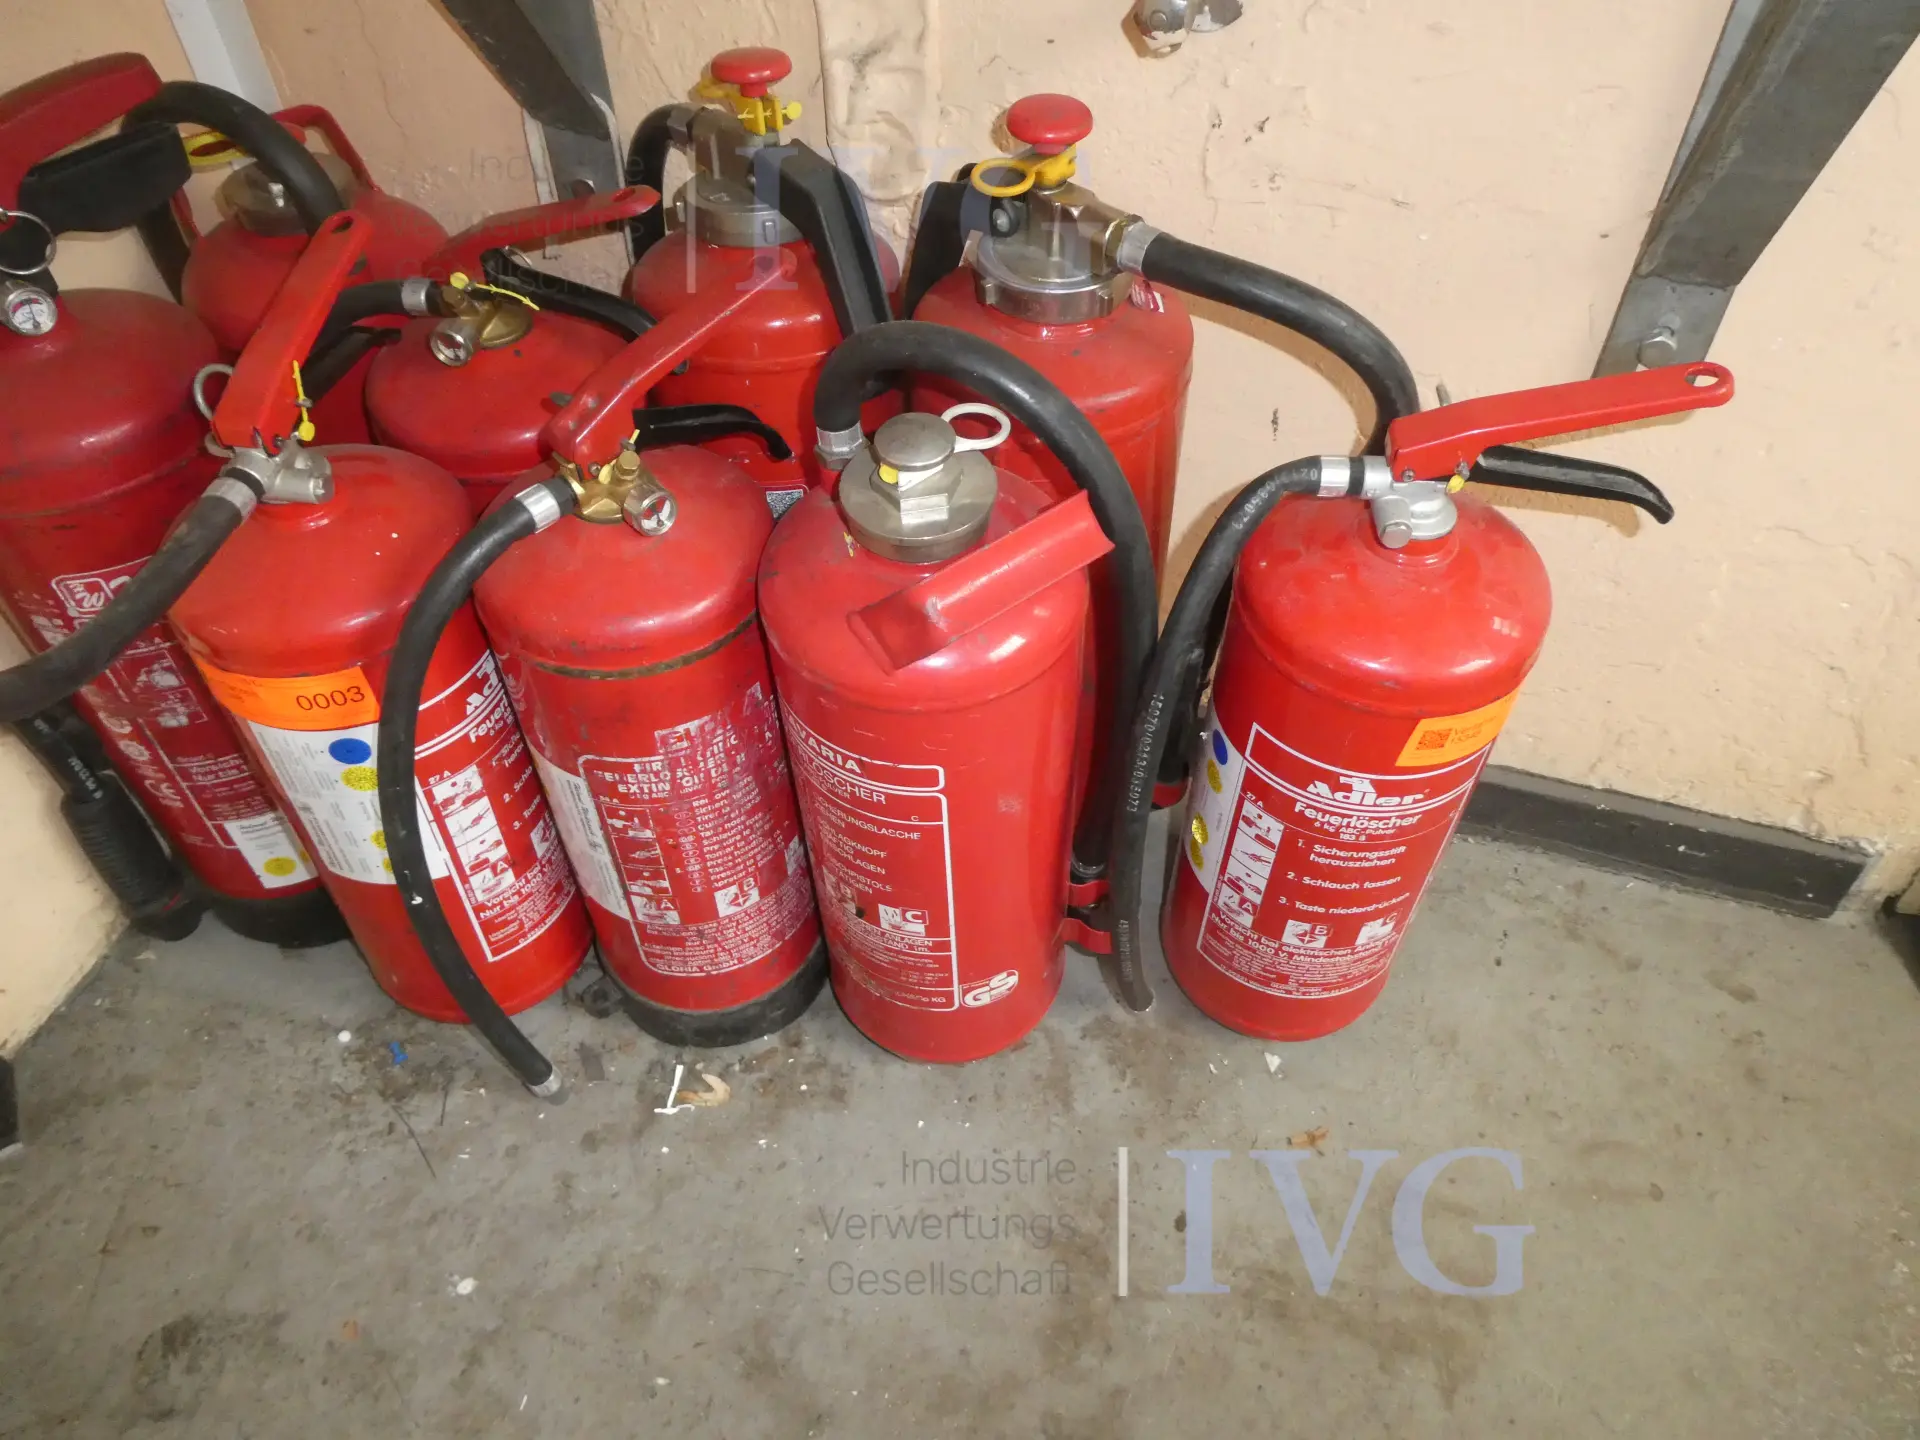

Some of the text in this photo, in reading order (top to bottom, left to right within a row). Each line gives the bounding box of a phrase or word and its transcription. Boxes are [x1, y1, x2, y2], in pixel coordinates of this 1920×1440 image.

[296, 685, 365, 711] 0003
[1306, 777, 1425, 806] Adler
[1294, 801, 1423, 829] Feuerlöscher
[1339, 826, 1396, 836] ABC-Pulver
[1297, 838, 1408, 860] 1. Sicherungsstift
[497, 860, 509, 873] A
[1309, 853, 1396, 868] herausziehen
[743, 877, 754, 890] B
[1286, 871, 1402, 890] 2. Schlauch fassen
[484, 877, 527, 906] Vorsicht
[660, 899, 675, 909] A
[1241, 901, 1254, 914] A
[1278, 896, 1289, 906] 3.
[1294, 900, 1326, 914] Taste
[480, 906, 501, 919] Nur
[905, 910, 923, 923] C
[1211, 912, 1228, 929] Nur
[1229, 927, 1244, 942] bis
[1248, 938, 1276, 955] 1000
[1219, 911, 1258, 940] Vorsicht
[1261, 936, 1280, 949] bei
[1281, 944, 1352, 957] elektrischen
[1314, 925, 1328, 935] B
[884, 933, 933, 947] ANLAGEN
[963, 971, 1018, 1007] GS
